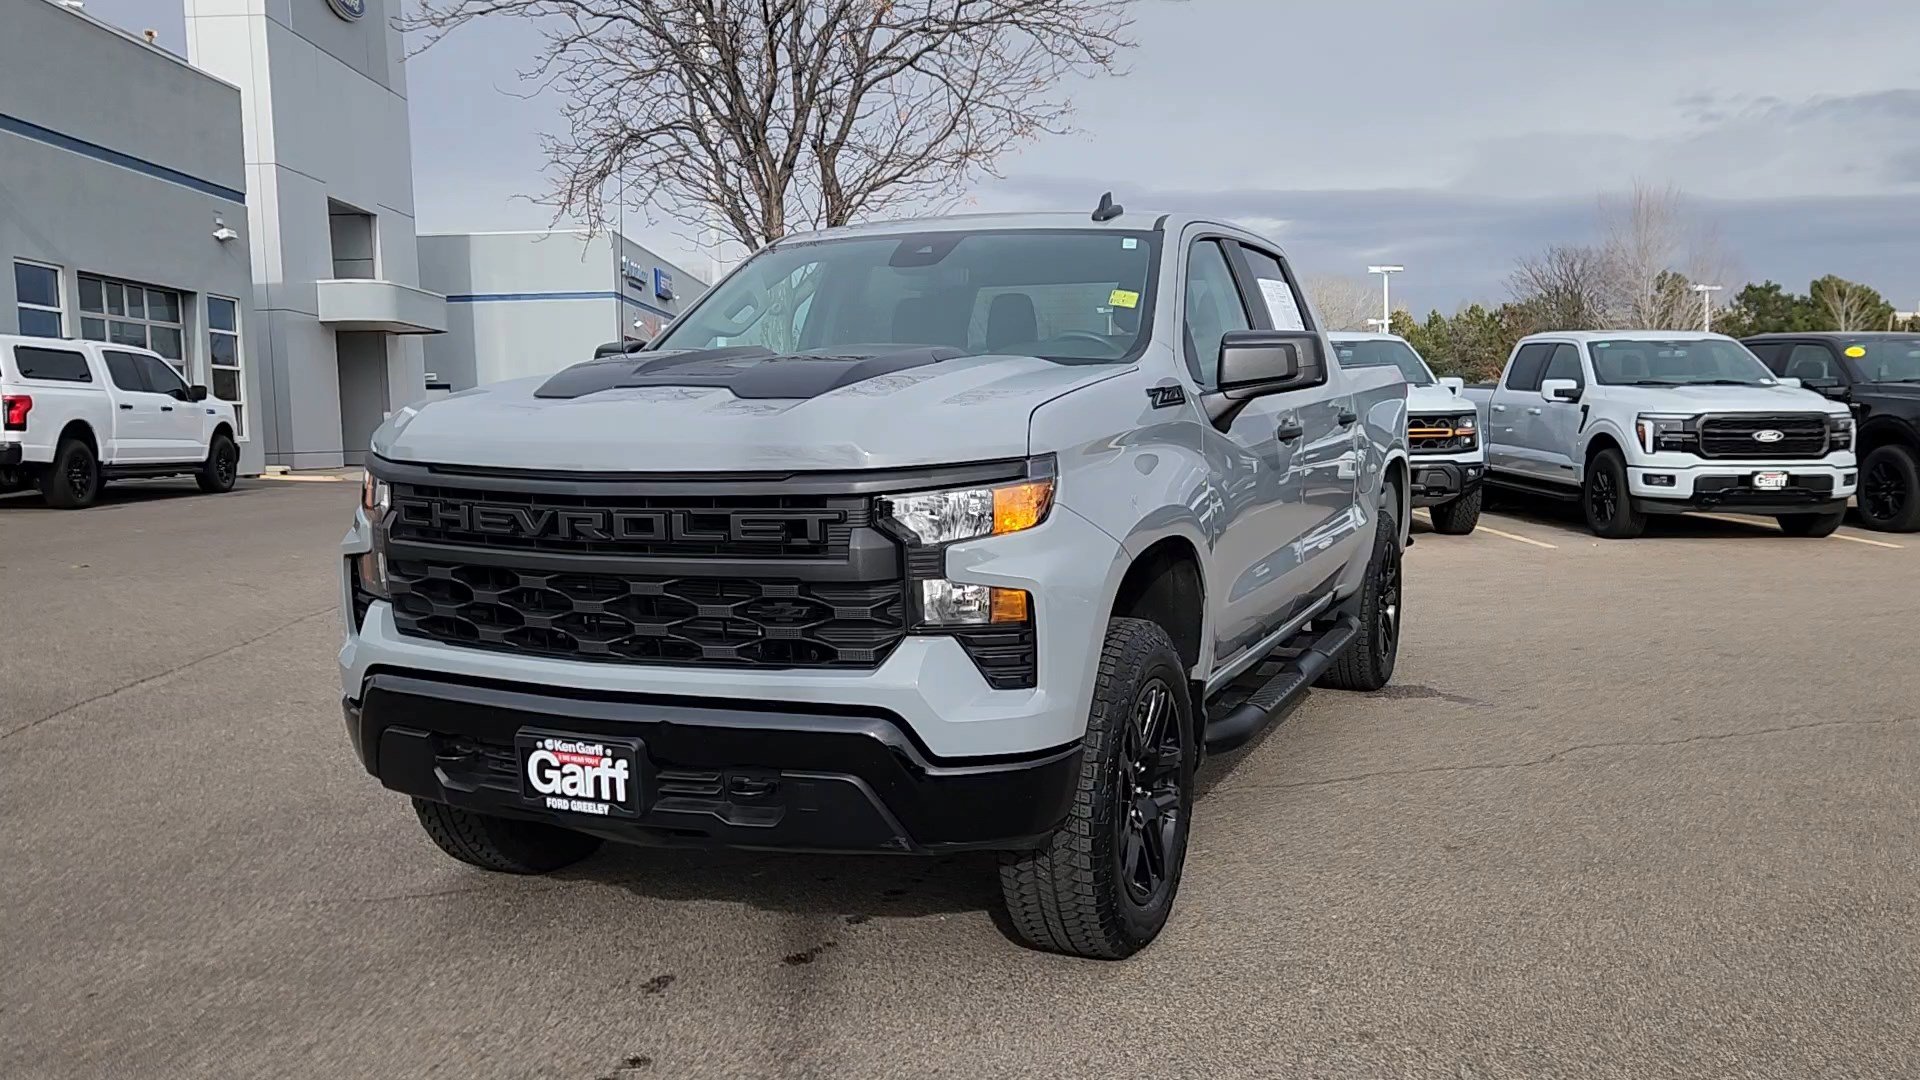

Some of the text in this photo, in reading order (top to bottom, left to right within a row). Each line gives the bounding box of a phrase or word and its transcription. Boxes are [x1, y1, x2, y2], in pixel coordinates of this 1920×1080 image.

[1146, 385, 1186, 410] Z71
[399, 499, 847, 543] CHEVROLET
[554, 739, 604, 756] Ken Garff
[528, 750, 629, 802] Garff
[546, 797, 609, 815] FORD GREELEY
